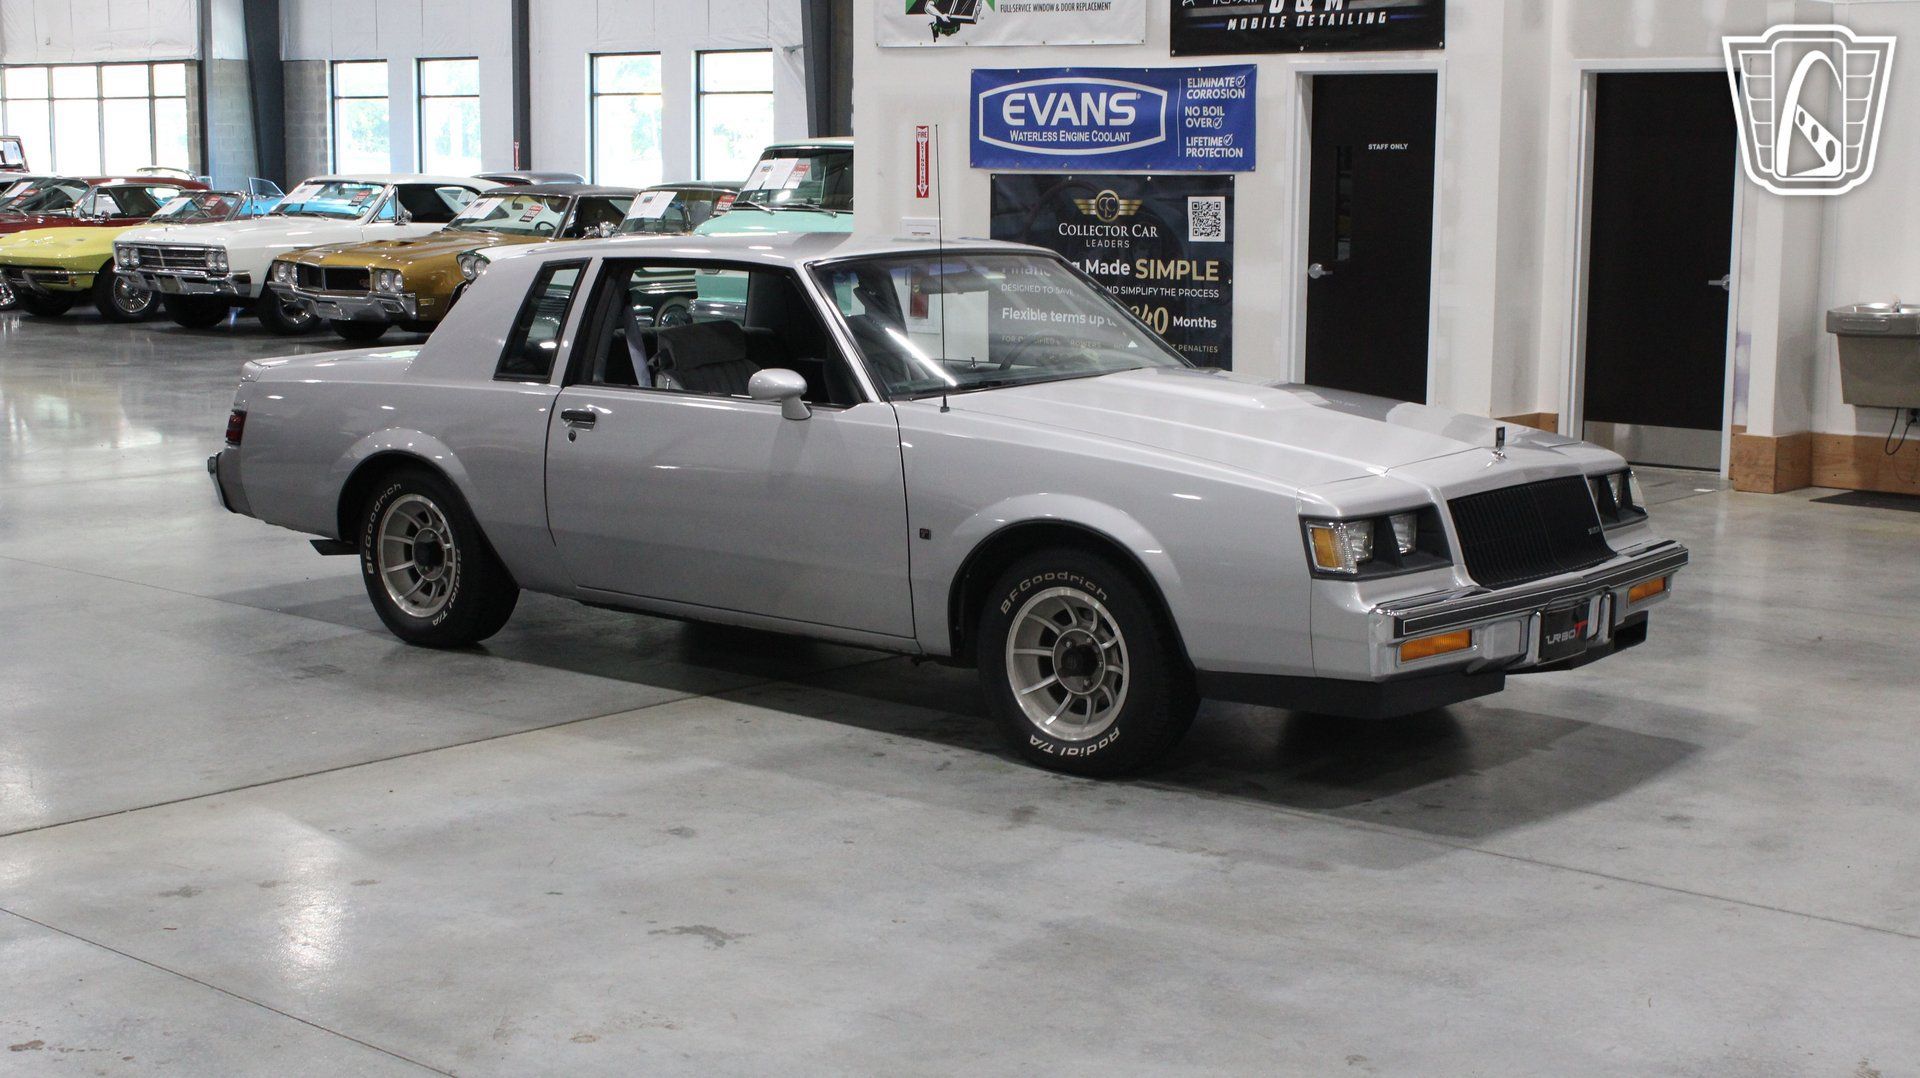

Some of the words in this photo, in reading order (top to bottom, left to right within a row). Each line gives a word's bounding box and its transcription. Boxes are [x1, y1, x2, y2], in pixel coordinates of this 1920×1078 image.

[1033, 3, 1055, 12] WINDOW
[1055, 3, 1060, 12] &
[1061, 3, 1075, 12] DOOR
[1076, 2, 1111, 12] REPLACEMENT
[1227, 15, 1288, 31] MOBILE
[1296, 11, 1388, 27] DETAILING
[1187, 77, 1235, 88] ELIMINATE
[1186, 88, 1245, 99] CORROSION
[1002, 92, 1137, 126] EVANS
[1185, 106, 1200, 117] NO
[1202, 106, 1225, 117] BOIL
[1185, 117, 1213, 128] OVER
[1010, 130, 1057, 142] WATERLESS
[1059, 130, 1090, 142] ENGINE
[1091, 130, 1131, 142] COOLANT
[1186, 136, 1223, 147] LIFETIME
[1186, 147, 1243, 158] PROTECTION
[1058, 222, 1129, 237] COLLECTOR
[1132, 224, 1158, 238] CAR
[1086, 240, 1130, 248] LEADERS
[1085, 259, 1130, 276] Made
[1135, 259, 1219, 281] SIMPLE
[1042, 285, 1054, 294] TO
[1104, 286, 1119, 295] ND
[1120, 286, 1158, 297] SIMPLIFY
[1159, 288, 1176, 297] THE
[1178, 288, 1219, 298] PROCESS
[1002, 307, 1048, 322] Flexible
[1050, 310, 1086, 324] terms
[1089, 315, 1105, 328] up
[1173, 316, 1217, 328] Months
[1178, 344, 1219, 353] PENALTIES
[1000, 571, 1109, 615] BFGoodrich
[1029, 734, 1054, 754] T/A
[1059, 727, 1121, 757] Radial
